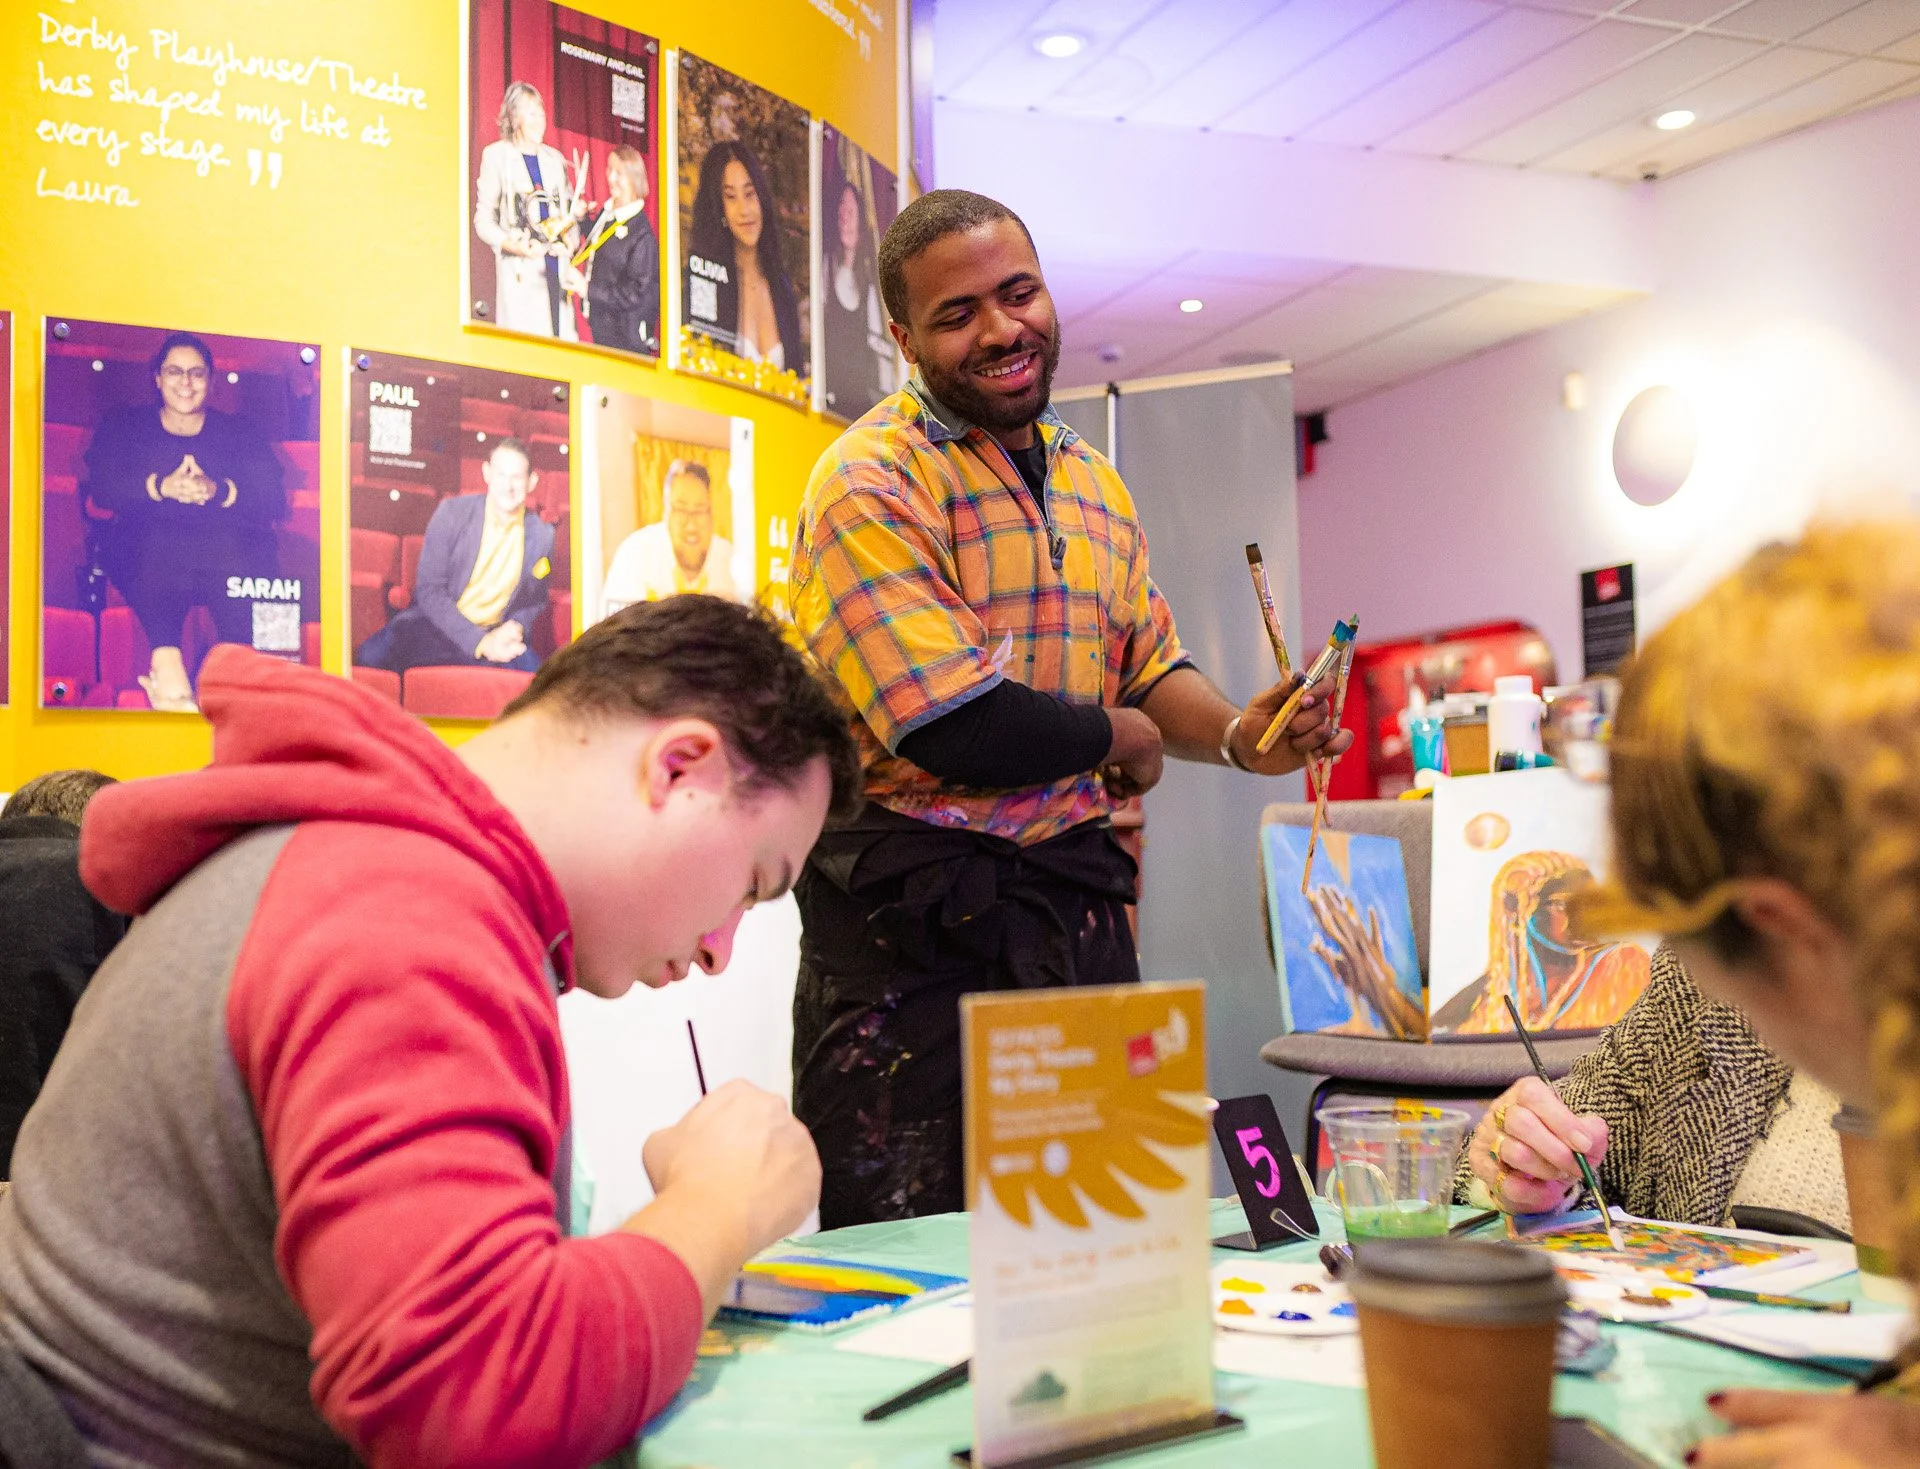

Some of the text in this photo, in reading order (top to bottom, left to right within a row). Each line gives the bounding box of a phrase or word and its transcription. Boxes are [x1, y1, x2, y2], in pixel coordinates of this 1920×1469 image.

[38, 12, 428, 110] Derby Playhouse/Theatre
[560, 41, 608, 67] ROSEMARY
[606, 56, 626, 74] AND
[37, 60, 392, 148] has shaped my life at
[36, 119, 130, 168] every
[36, 167, 139, 207] Laura
[689, 254, 730, 285] OLIVIA
[369, 381, 421, 408] PAUL
[226, 576, 301, 601] SARAH
[1235, 1126, 1281, 1199] 5
